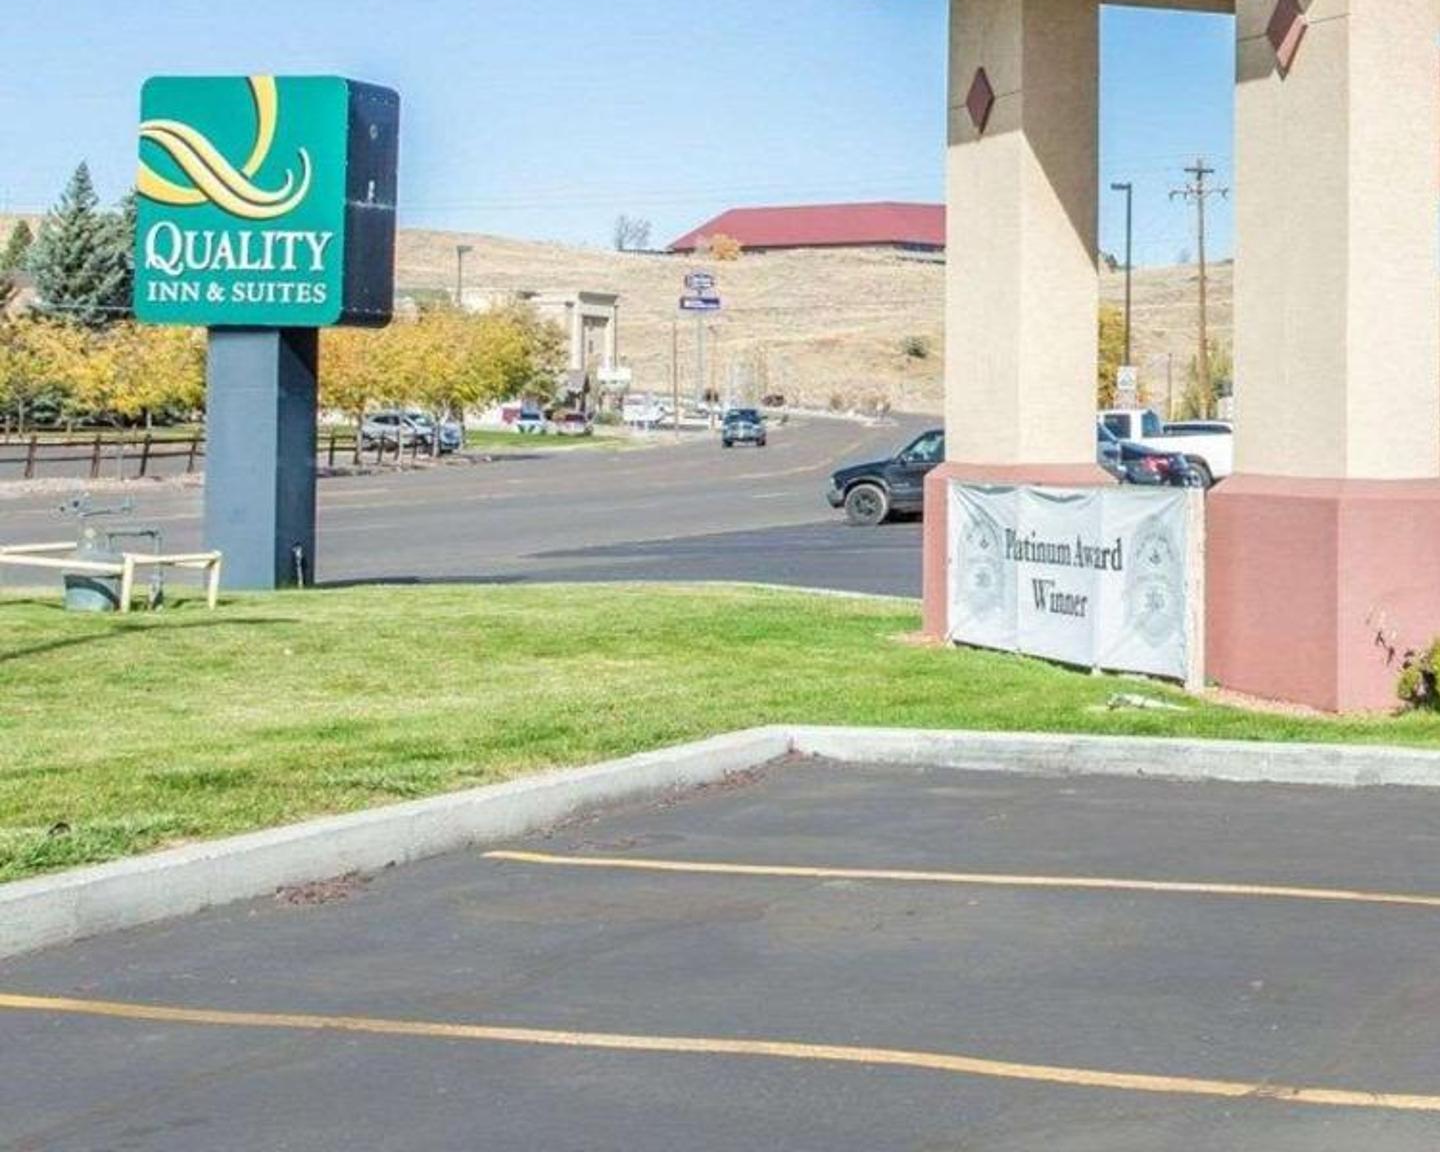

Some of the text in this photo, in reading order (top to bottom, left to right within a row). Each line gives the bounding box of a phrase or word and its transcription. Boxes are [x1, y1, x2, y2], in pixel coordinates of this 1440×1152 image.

[145, 221, 333, 276] QUALITY
[148, 281, 327, 304] INN & SUITES
[1004, 528, 1123, 571] Platinum Award
[1032, 578, 1088, 618] Winner
